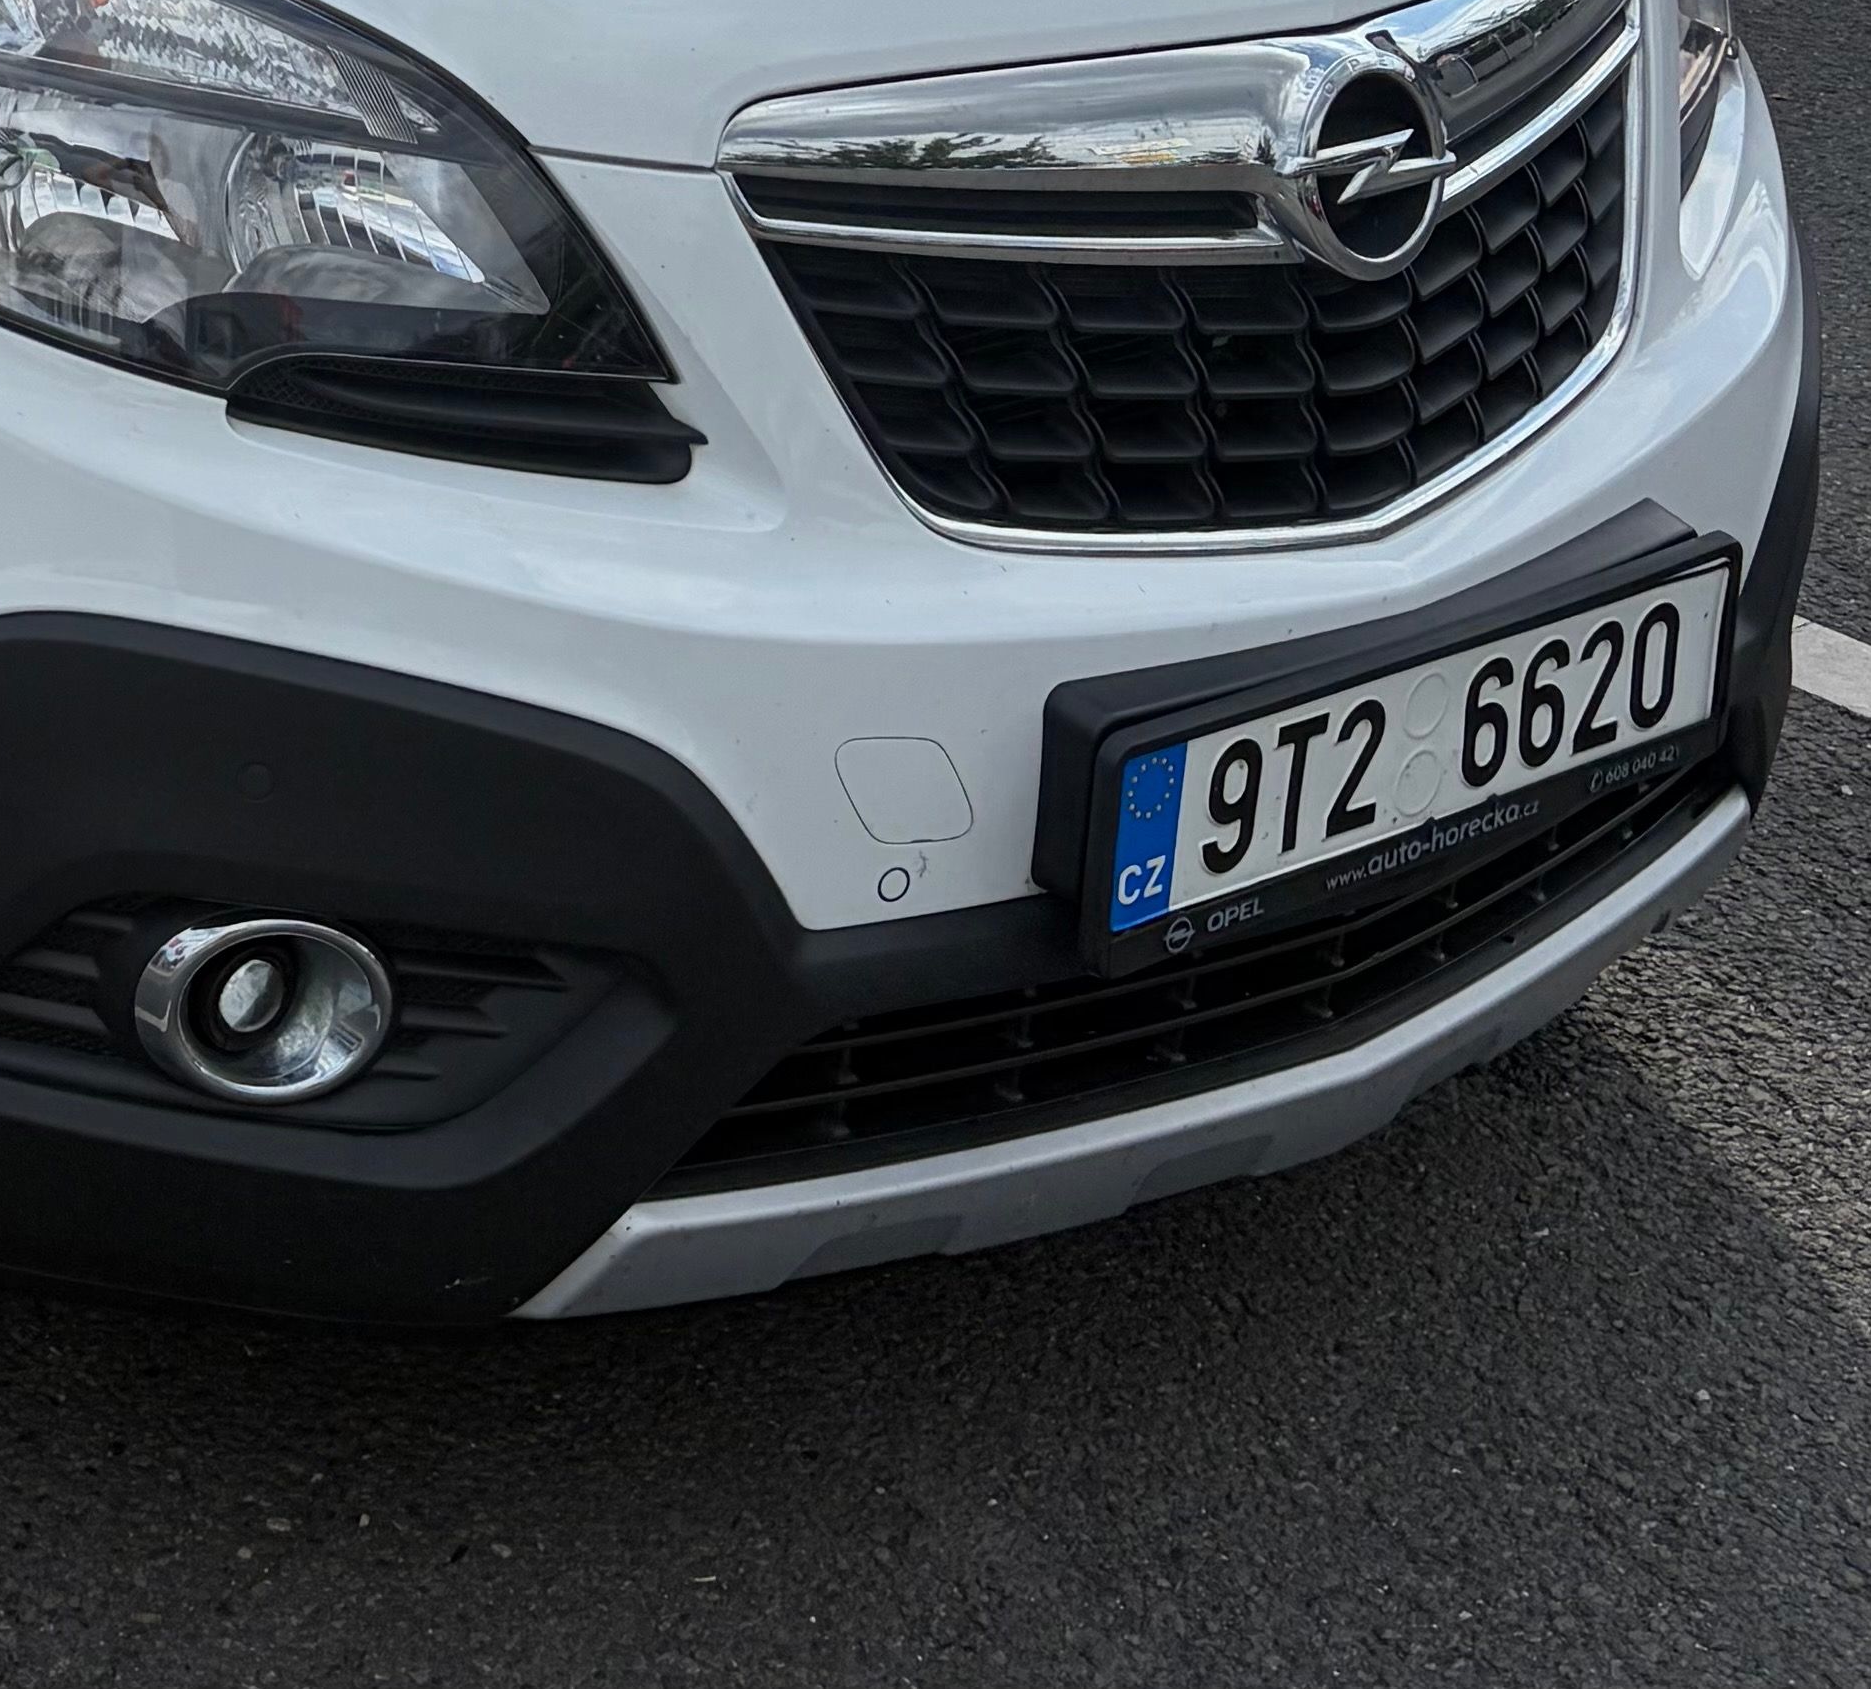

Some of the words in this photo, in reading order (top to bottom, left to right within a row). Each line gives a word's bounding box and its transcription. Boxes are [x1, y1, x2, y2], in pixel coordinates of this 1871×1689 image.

[1201, 698, 1386, 874] 9T2
[1460, 602, 1680, 787] 6620
[1117, 856, 1165, 905] CZ
[1325, 797, 1539, 893] www.auto-horecka.cz
[1207, 896, 1264, 933] OPEL
